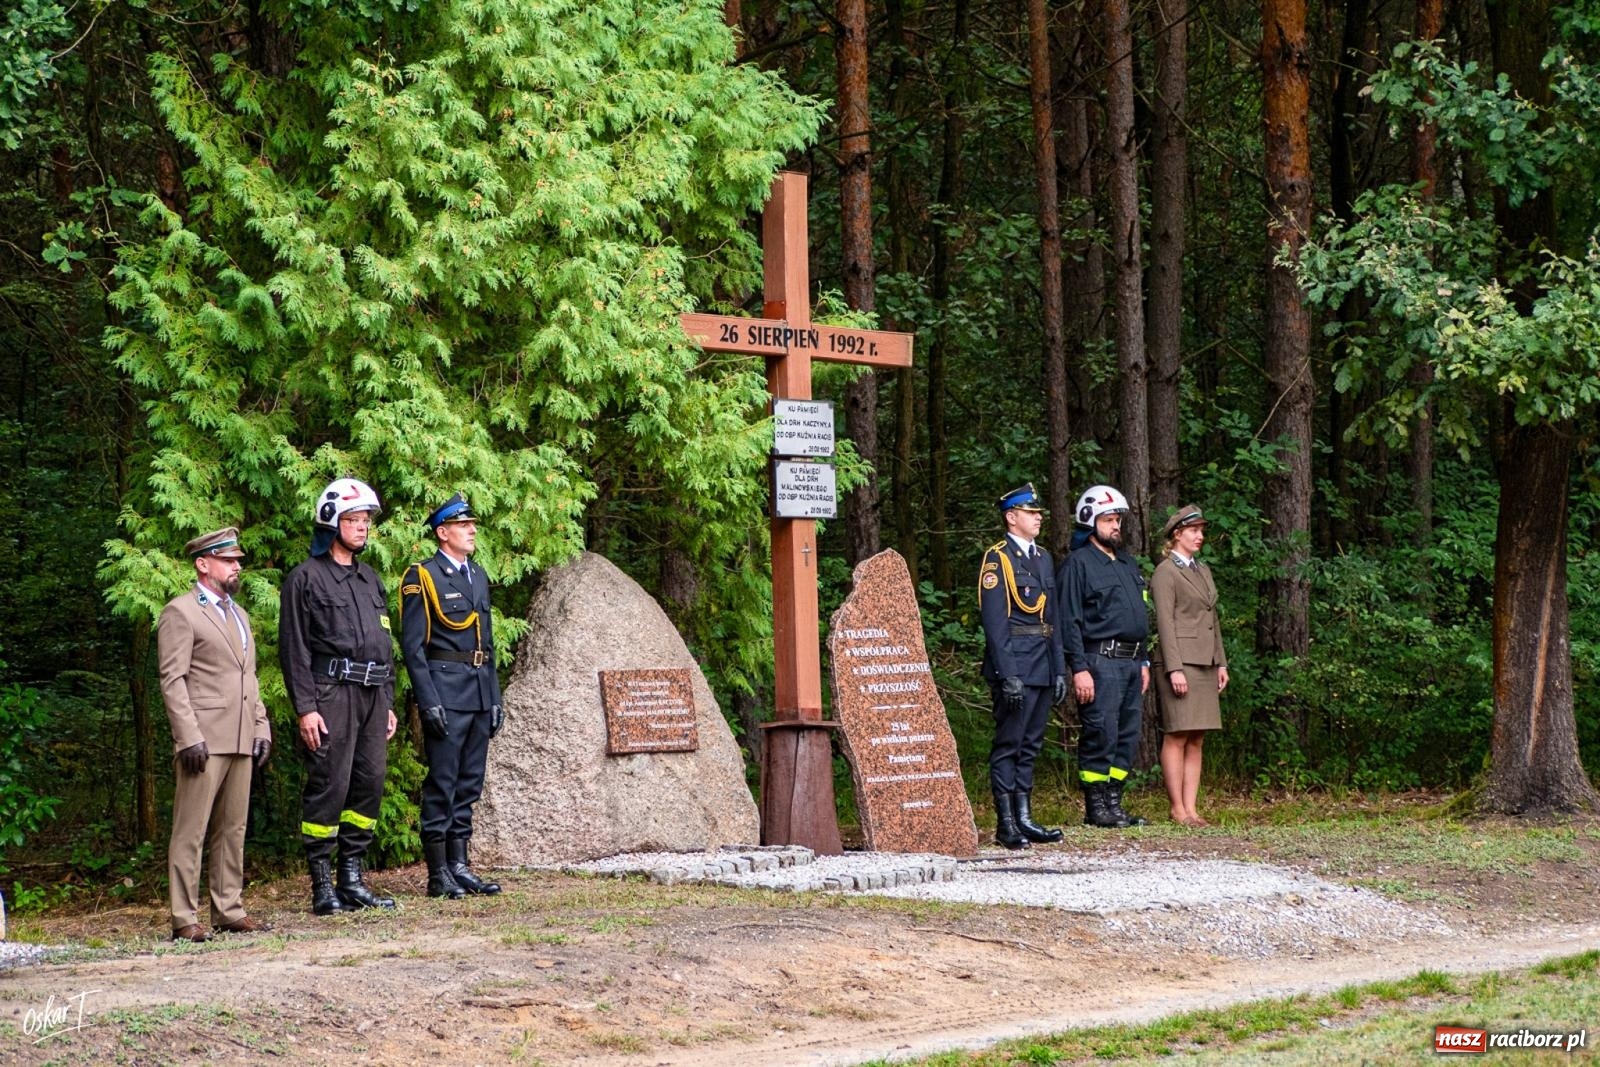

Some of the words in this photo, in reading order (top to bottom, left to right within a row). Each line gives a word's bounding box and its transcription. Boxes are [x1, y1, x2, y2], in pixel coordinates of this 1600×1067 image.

[720, 323, 739, 344] 26
[748, 325, 819, 350] SIERPIEŃ
[829, 333, 865, 355] 1992
[869, 342, 878, 356] r.
[781, 484, 828, 493] MALINOWSKIEGO
[844, 628, 890, 639] TRAGEDIA
[851, 644, 910, 657] WSPÓŁPRACA
[860, 662, 931, 675] DOŚWIADCZENIE
[867, 679, 922, 693] PRZYSZŁOŚĆ
[891, 722, 899, 731] 25
[900, 721, 910, 731] lat
[871, 737, 881, 747] po
[881, 733, 908, 744] wielkim
[909, 733, 935, 744] pożarze
[888, 754, 926, 765] Pamiętamy
